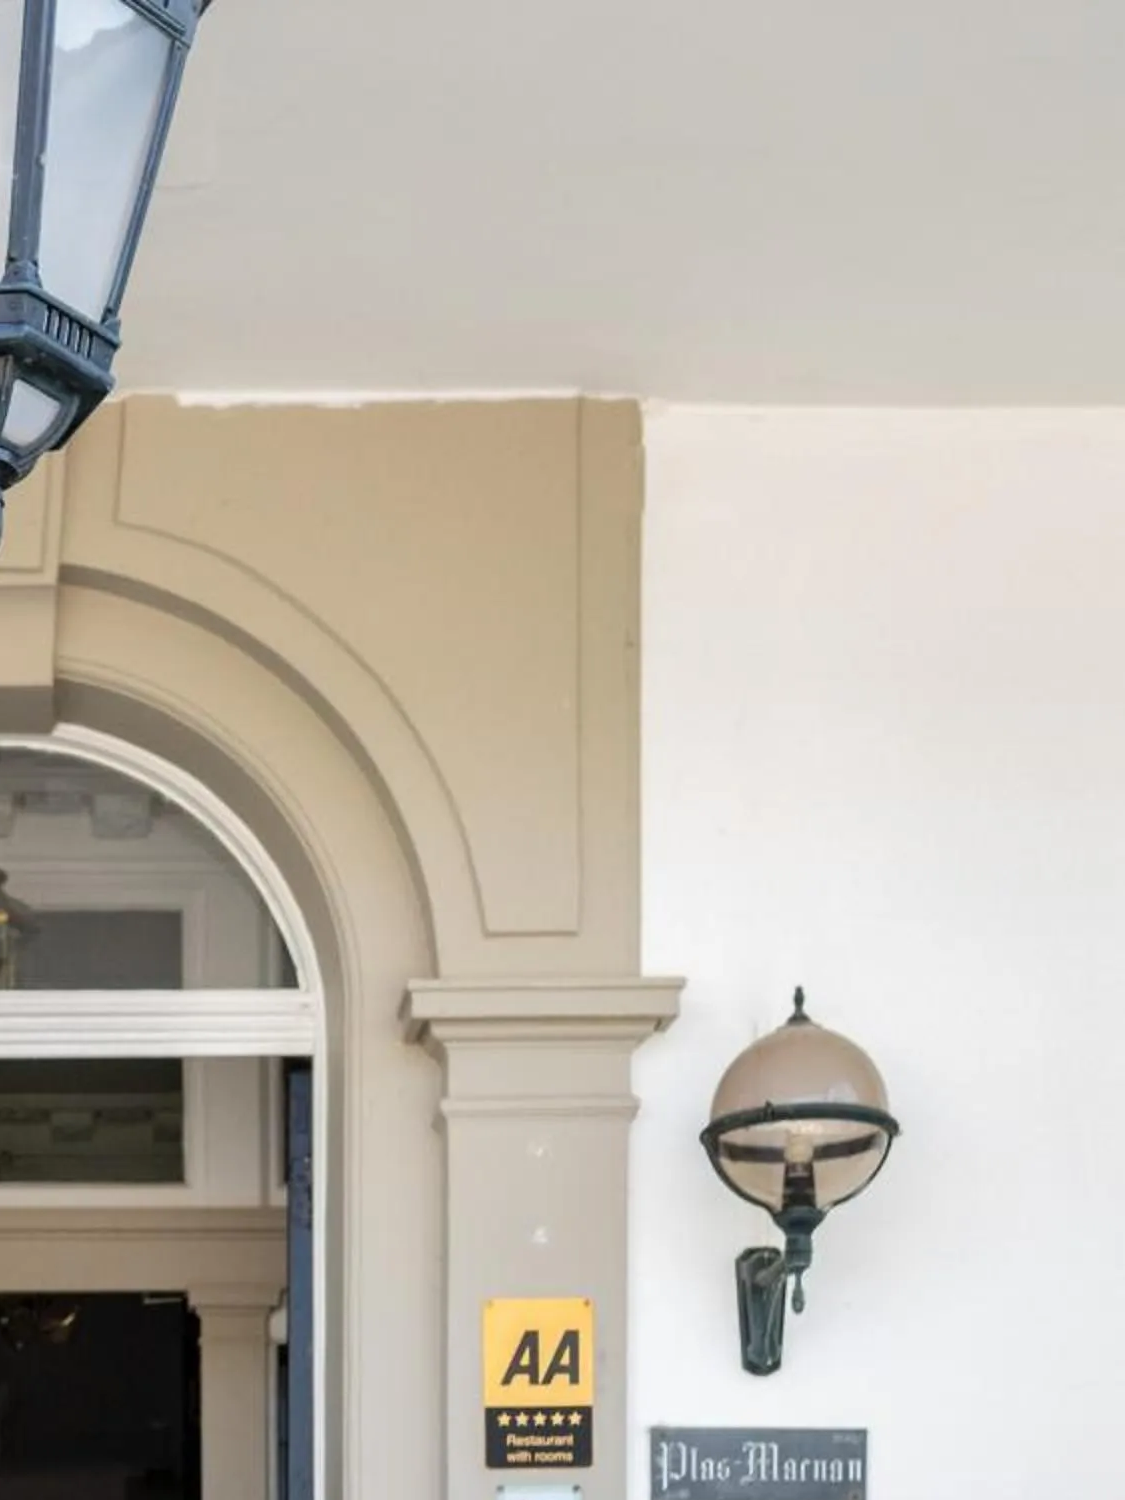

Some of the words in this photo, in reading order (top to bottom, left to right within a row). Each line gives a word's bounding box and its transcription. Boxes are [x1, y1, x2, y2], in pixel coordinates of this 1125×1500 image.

[500, 1329, 581, 1386] AA
[506, 1433, 574, 1447] Restaurant
[506, 1450, 532, 1464] with
[534, 1451, 574, 1464] rooms
[657, 1440, 731, 1491] Plas
